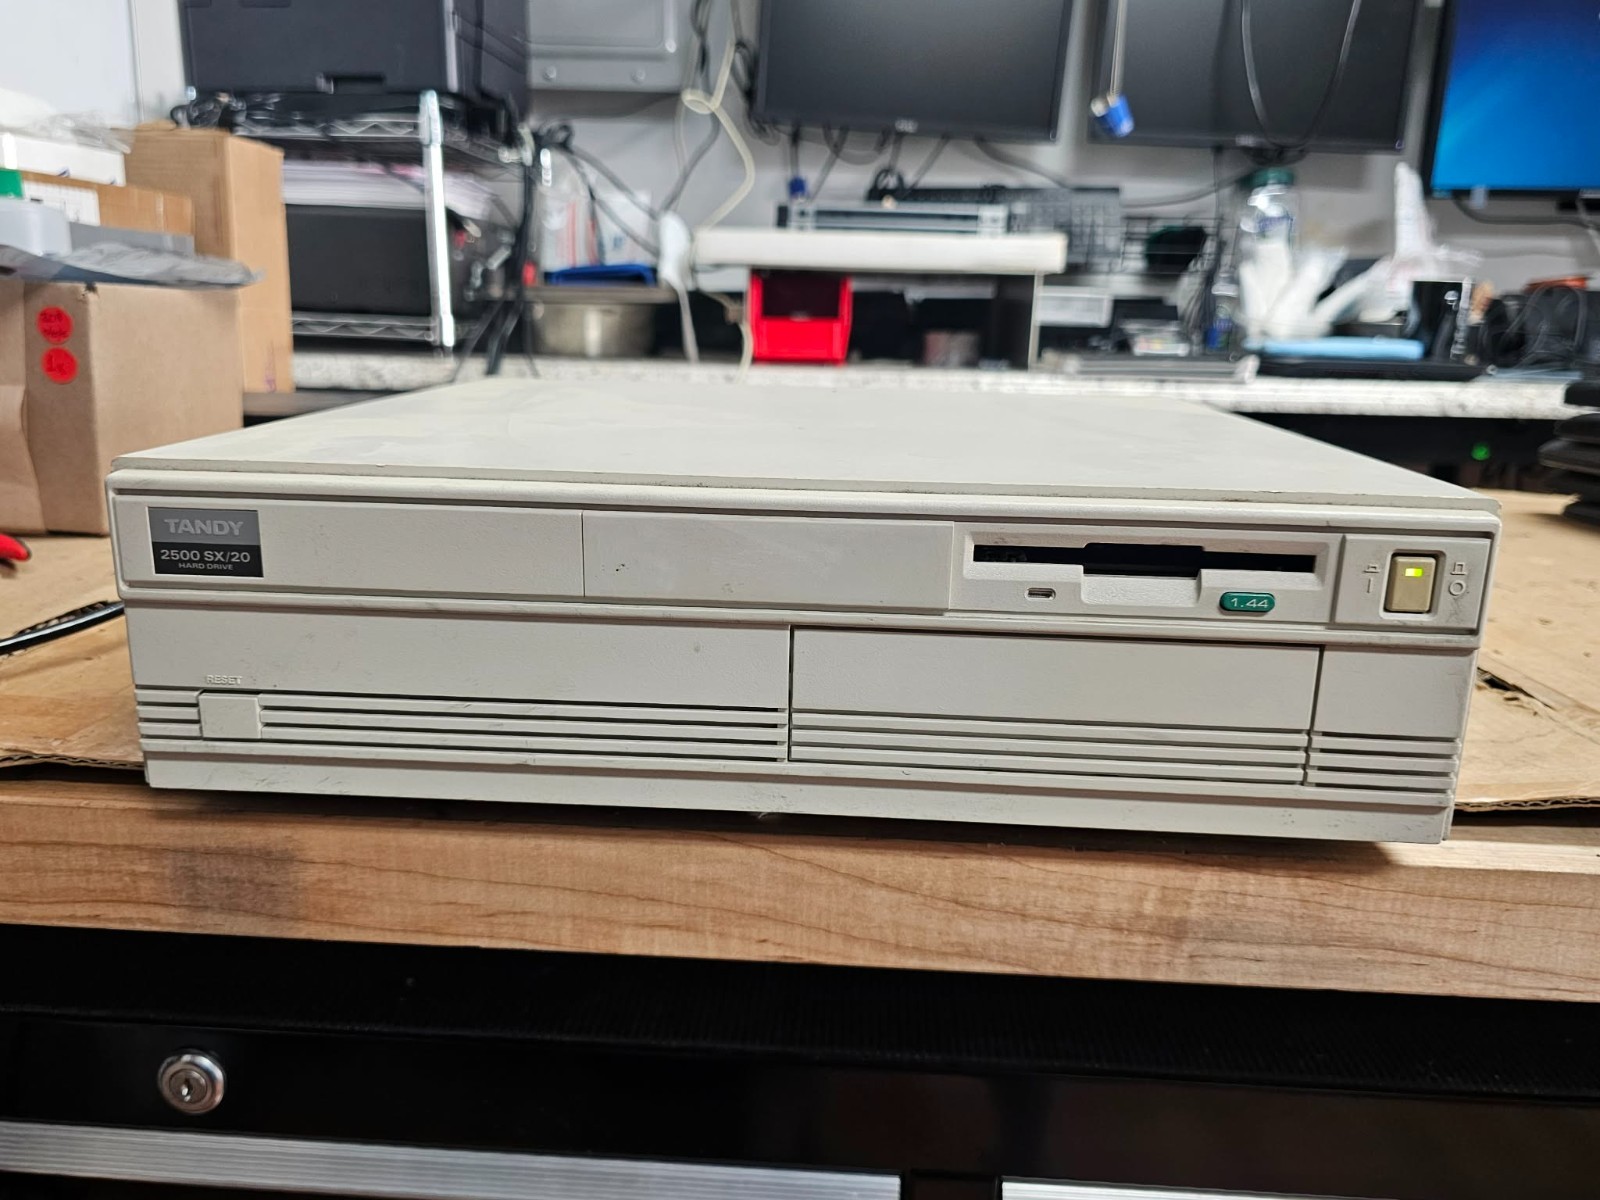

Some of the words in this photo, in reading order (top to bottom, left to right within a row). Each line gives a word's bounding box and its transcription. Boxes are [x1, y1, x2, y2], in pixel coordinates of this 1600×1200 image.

[163, 518, 244, 536] TANDY
[160, 549, 200, 561] 2500
[203, 550, 251, 563] SX/20
[206, 563, 234, 571] DRIVE
[1230, 597, 1269, 608] 1.44
[206, 674, 243, 685] RESET
